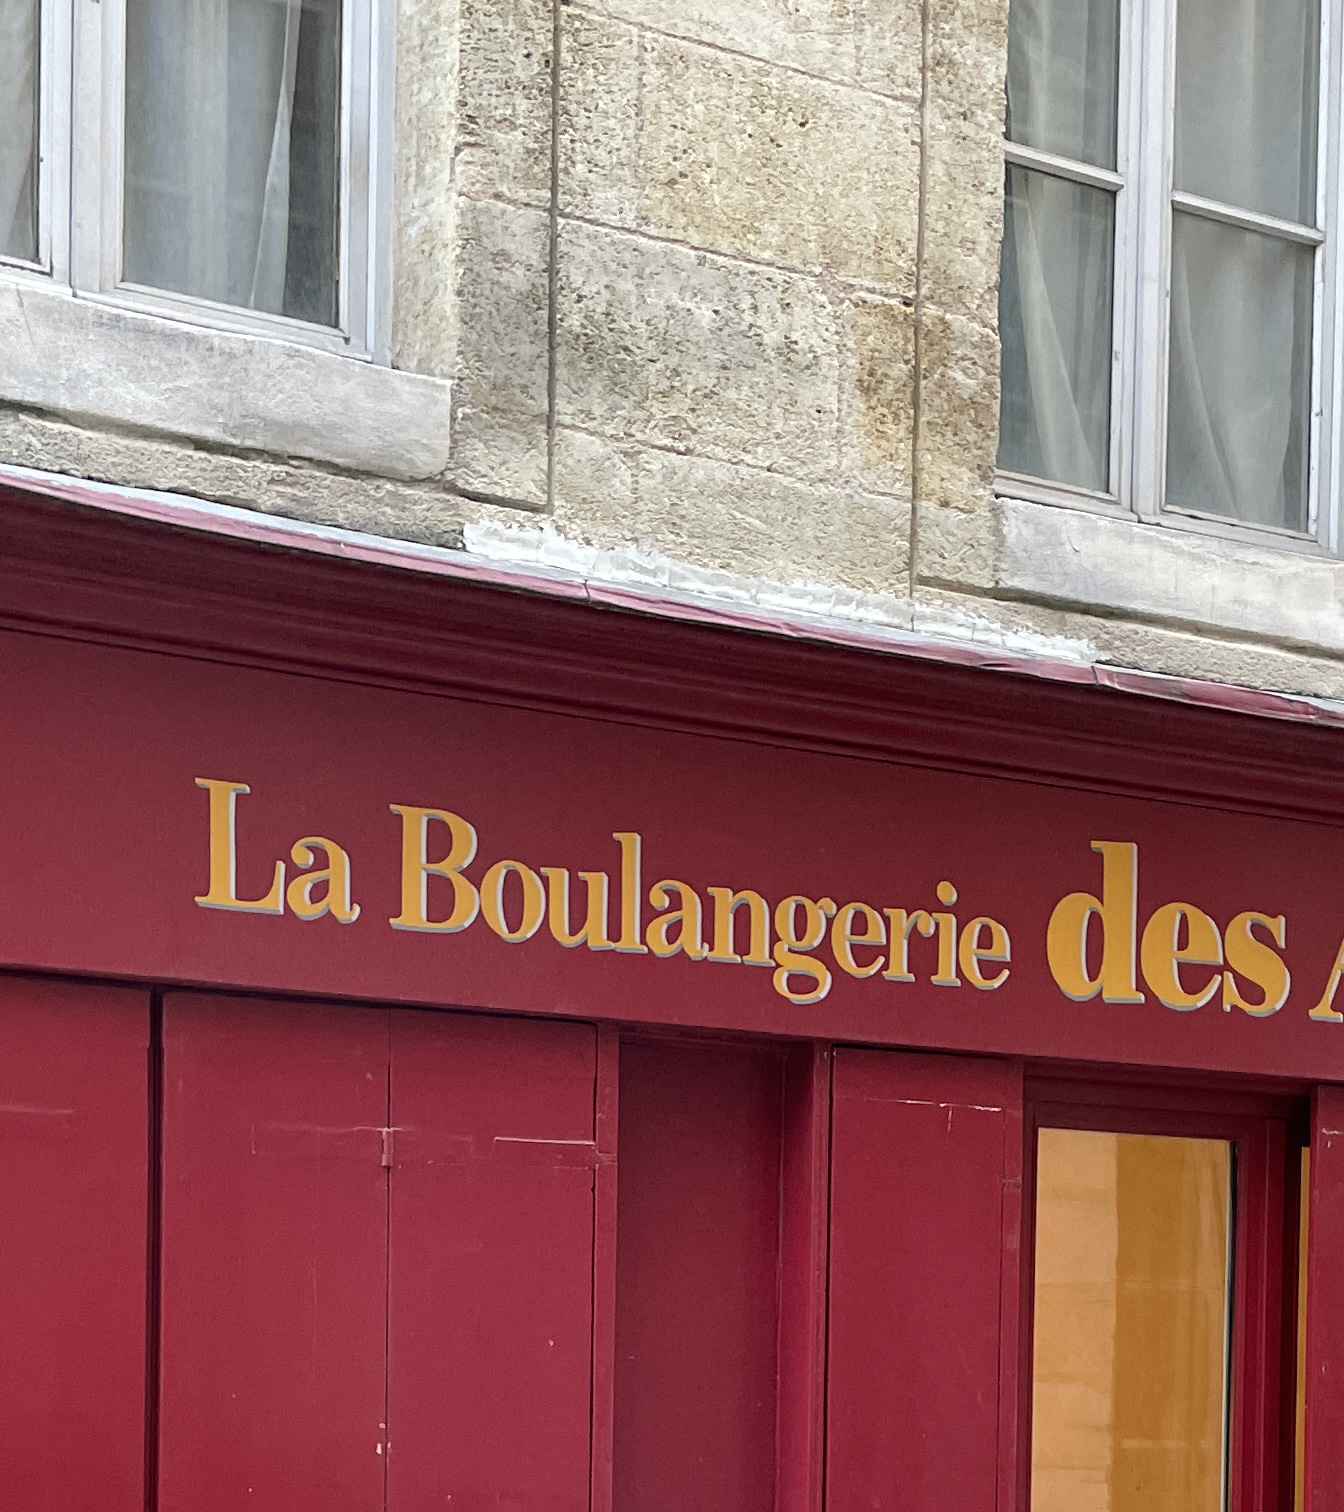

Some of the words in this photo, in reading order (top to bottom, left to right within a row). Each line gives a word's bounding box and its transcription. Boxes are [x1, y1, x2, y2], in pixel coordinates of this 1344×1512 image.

[194, 778, 360, 924] La
[389, 804, 1011, 1004] Boulangerie
[1047, 841, 1290, 1017] des
